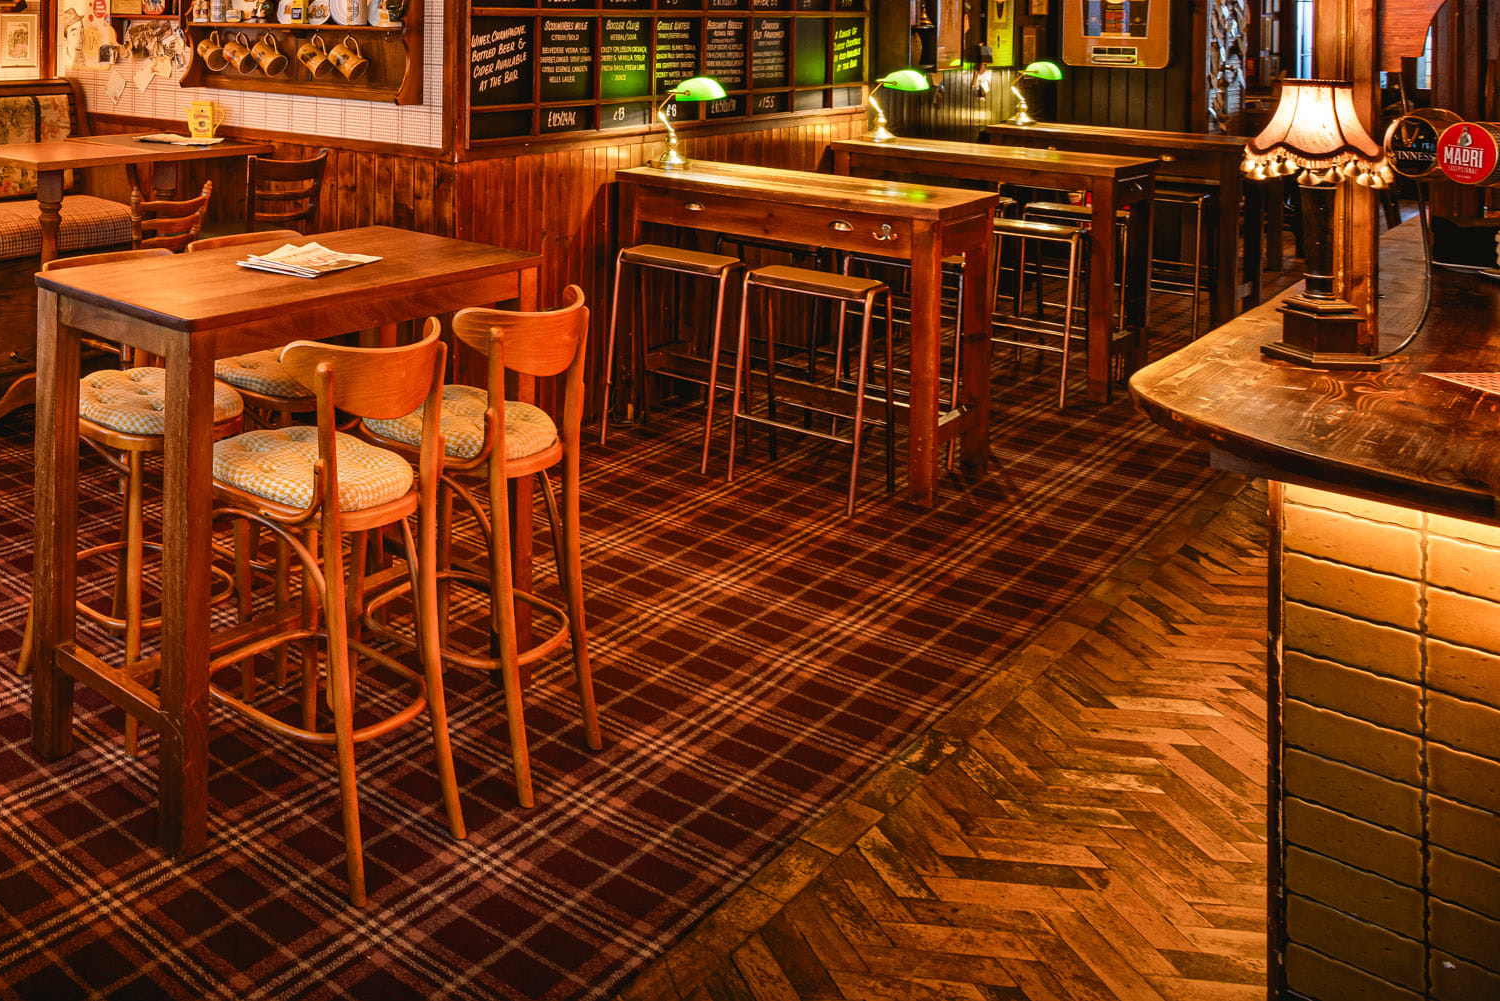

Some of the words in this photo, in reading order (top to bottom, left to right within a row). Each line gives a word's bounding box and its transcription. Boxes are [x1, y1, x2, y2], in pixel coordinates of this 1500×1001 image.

[498, 42, 515, 55] BEER
[473, 63, 494, 78] CIDER
[495, 51, 527, 71] AVAILABLE
[479, 80, 488, 92] AT
[489, 75, 502, 88] THE
[504, 69, 519, 84] BAR
